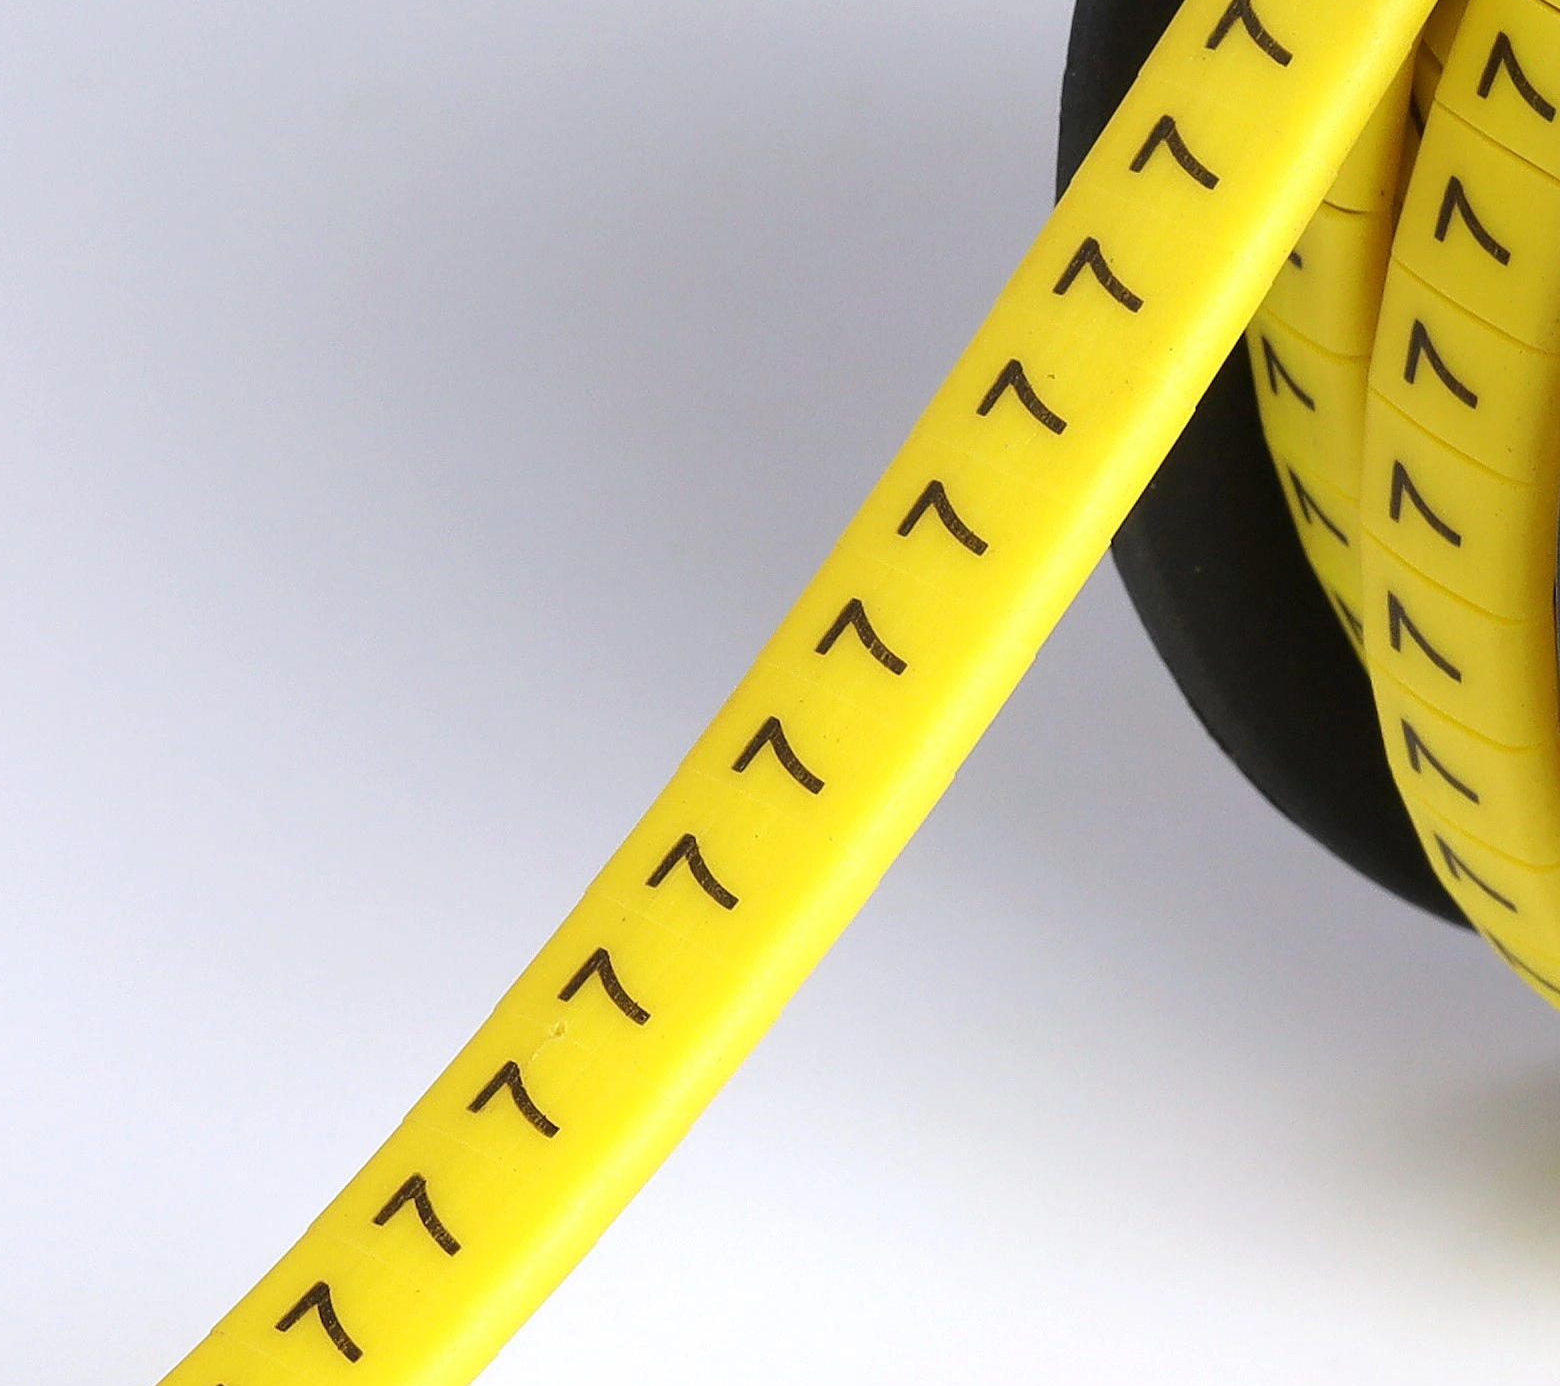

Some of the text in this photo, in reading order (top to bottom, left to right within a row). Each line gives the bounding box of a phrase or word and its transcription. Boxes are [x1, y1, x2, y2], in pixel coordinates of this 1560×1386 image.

[1475, 29, 1558, 124] 7
[1433, 174, 1512, 268] 7
[1257, 332, 1317, 413] 7
[1402, 317, 1480, 411] 7
[1284, 464, 1350, 548] 7
[1388, 458, 1463, 549] 7
[1386, 589, 1463, 684] 7
[274, 1280, 364, 1364] 7
[372, 1174, 462, 1257] 7
[467, 1059, 561, 1139] 7
[557, 946, 652, 1026] 7
[645, 832, 740, 911] 7
[731, 715, 826, 796] 7
[814, 597, 909, 677] 7
[896, 478, 990, 557] 7
[975, 358, 1068, 436] 7
[1052, 235, 1144, 314] 7
[1128, 113, 1221, 191] 7
[1400, 717, 1480, 805] 7
[1433, 833, 1518, 914] 7
